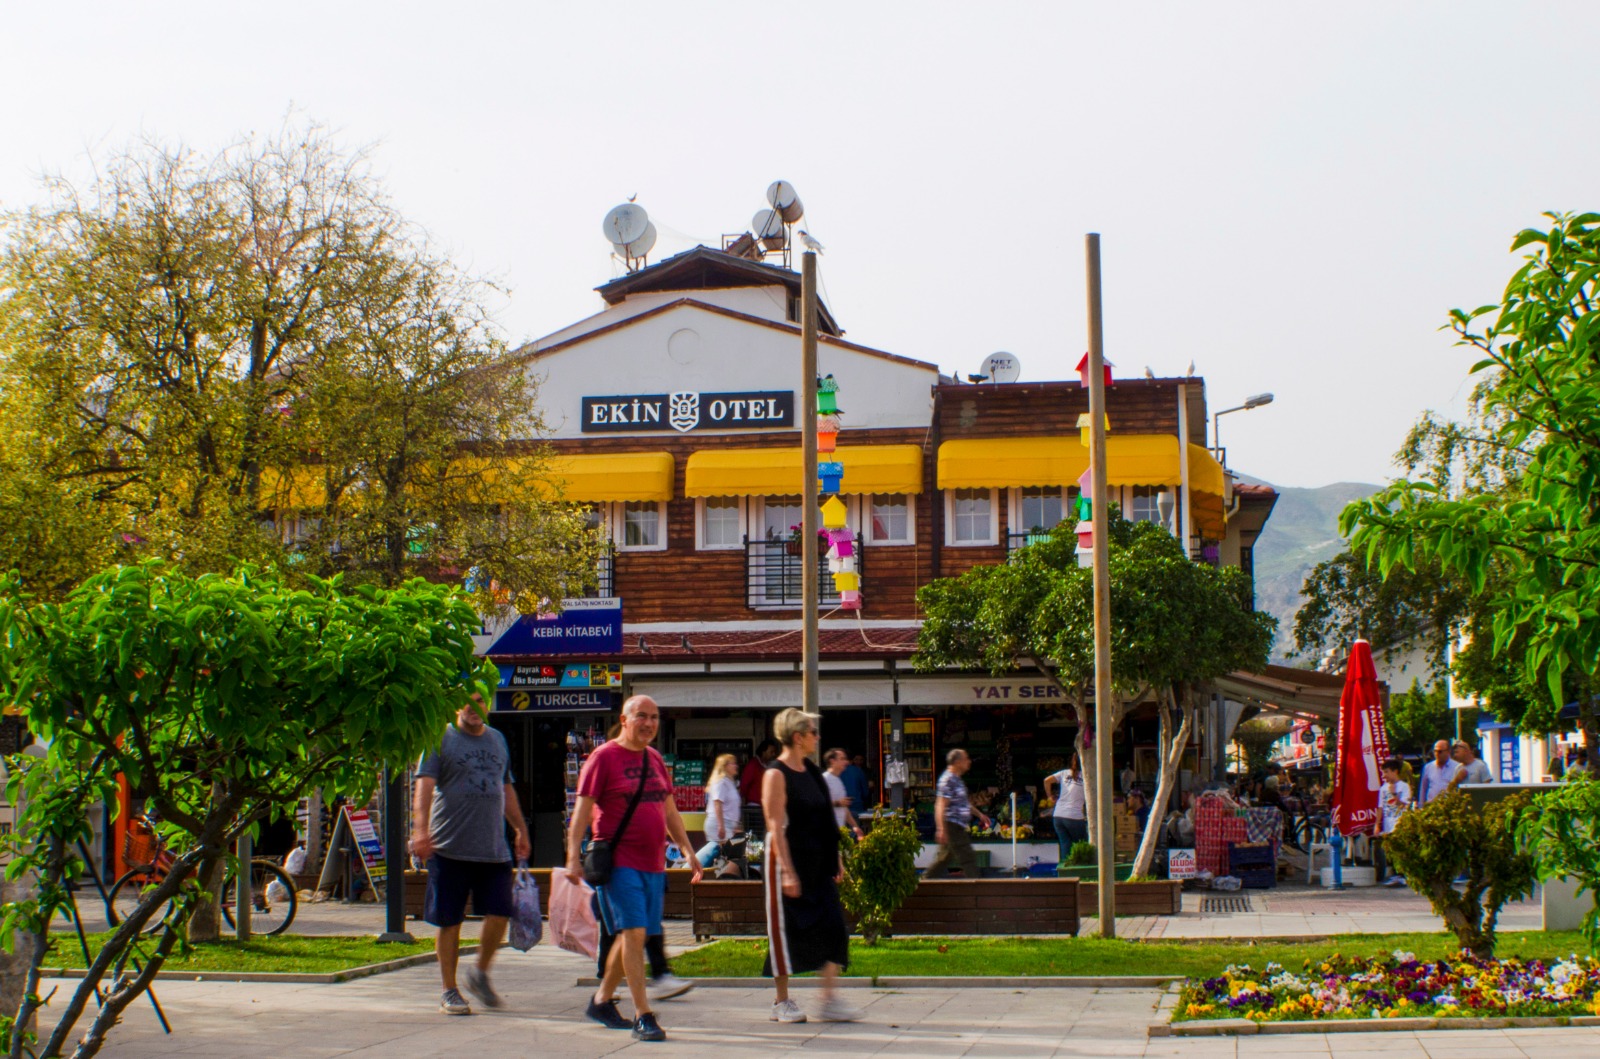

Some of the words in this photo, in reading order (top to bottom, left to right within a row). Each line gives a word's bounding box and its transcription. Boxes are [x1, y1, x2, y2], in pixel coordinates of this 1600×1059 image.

[591, 399, 662, 424] EKİN
[709, 399, 784, 421] OTEL
[533, 625, 563, 638] KEBİR
[565, 623, 612, 637] KİTABEVİ
[517, 666, 540, 675] Bayrak
[513, 676, 526, 685] Ülke
[527, 676, 557, 686] Bayrakları
[972, 686, 1012, 699] YAT
[535, 693, 601, 706] TURKCELL
